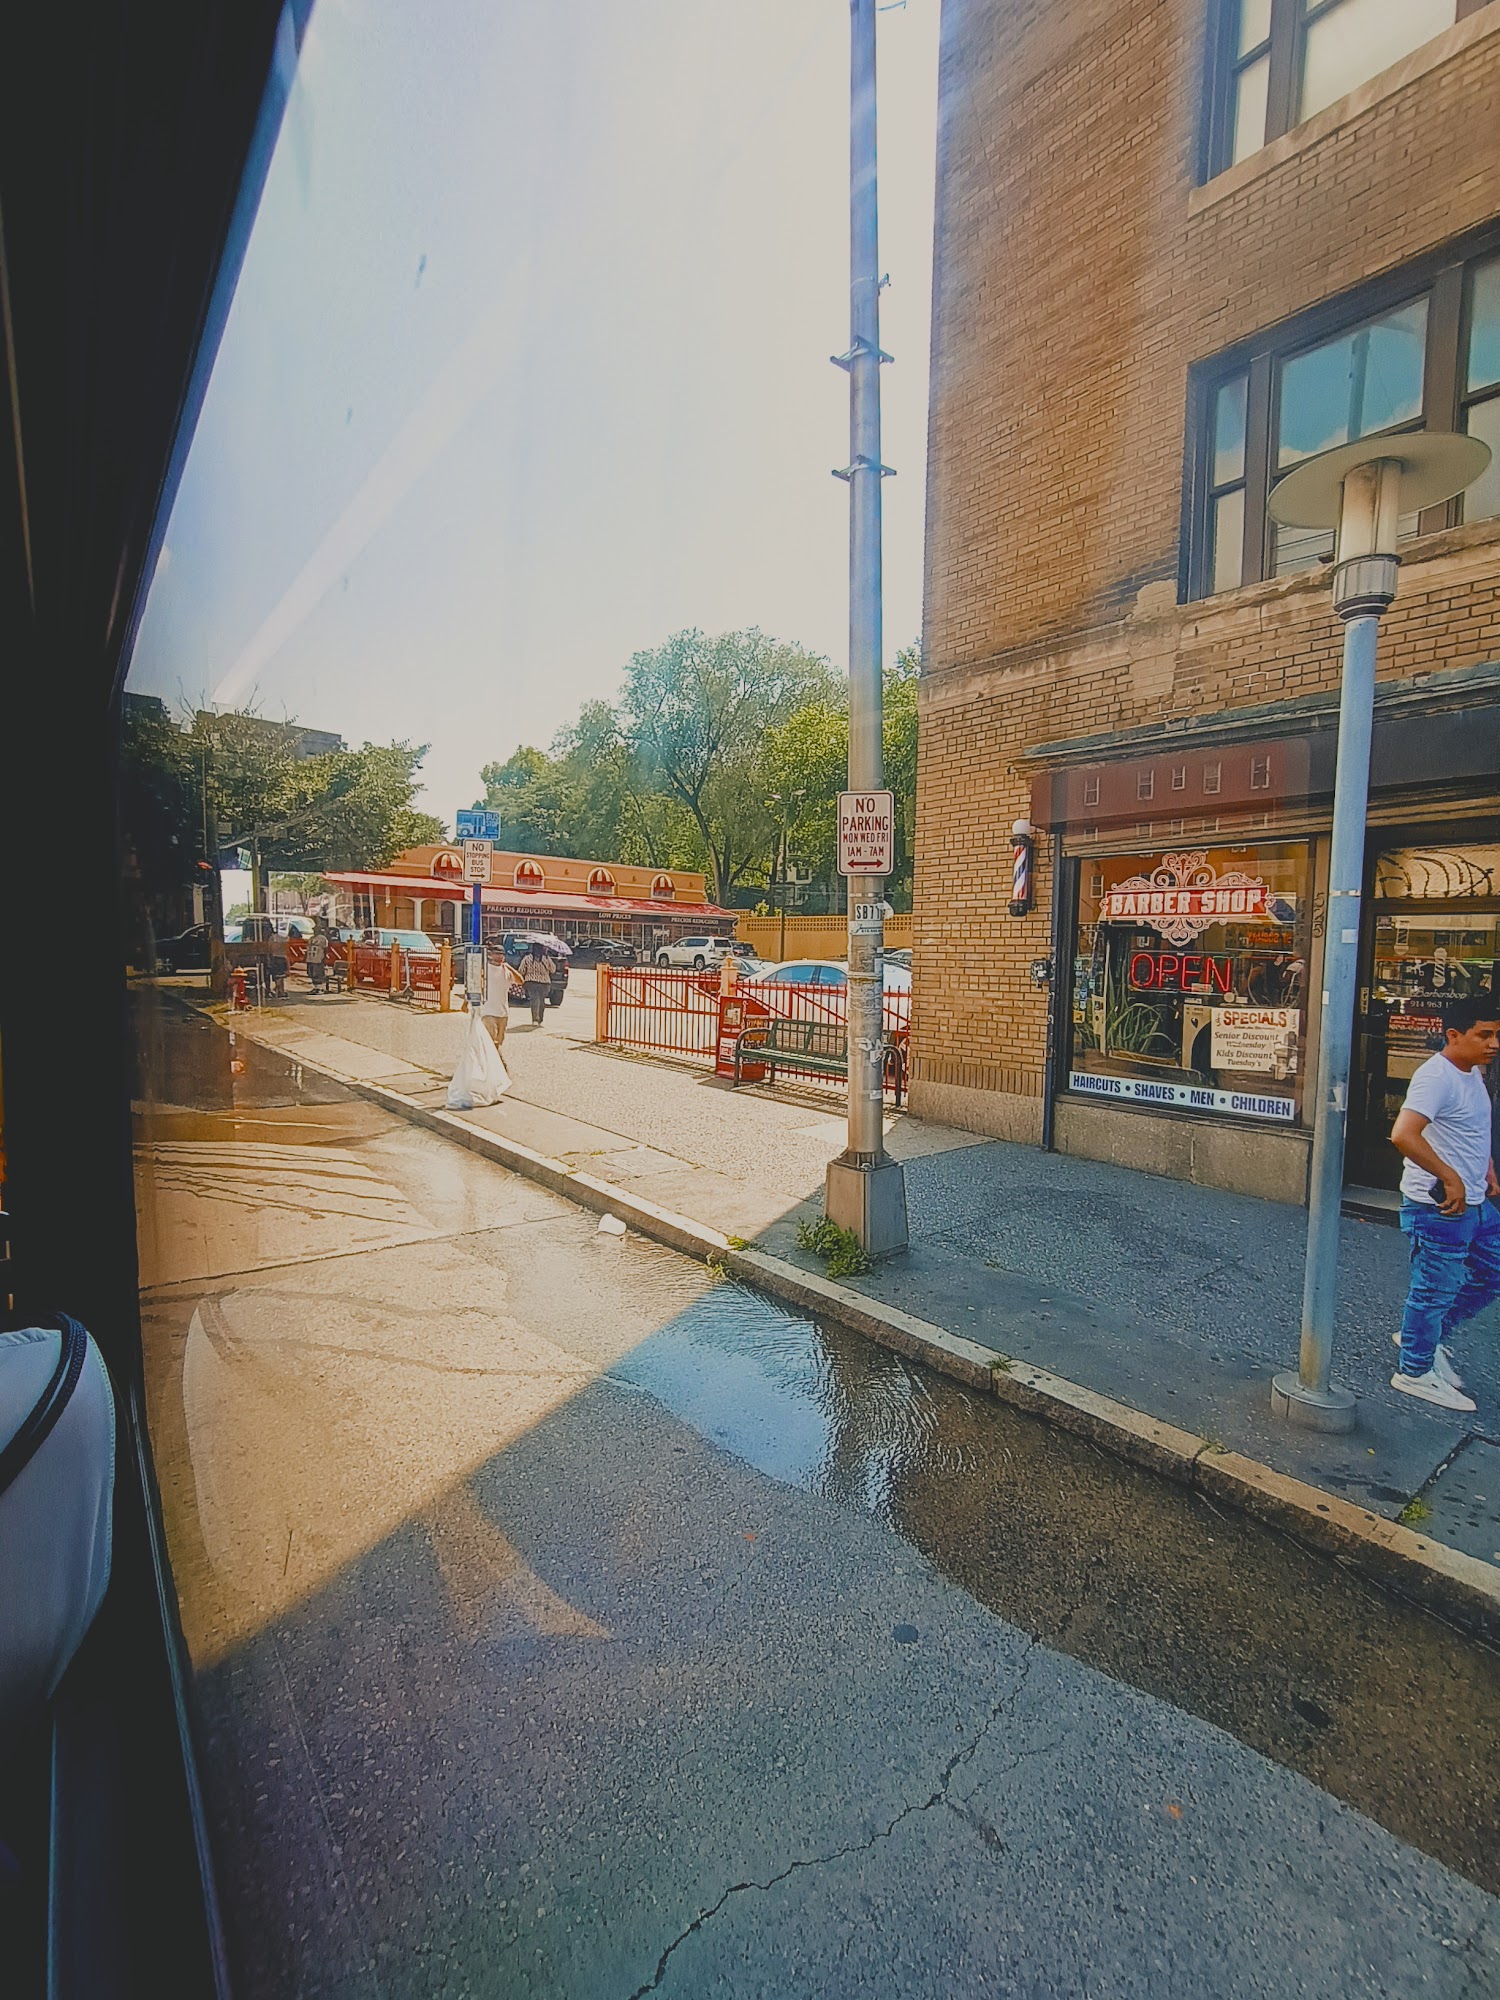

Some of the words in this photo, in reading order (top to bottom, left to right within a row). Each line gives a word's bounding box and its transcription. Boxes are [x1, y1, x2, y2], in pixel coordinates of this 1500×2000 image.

[855, 797, 876, 813] NO
[842, 815, 889, 832] PARKING
[842, 832, 859, 843] MON
[860, 832, 875, 843] WED
[877, 832, 889, 843] FRI
[472, 843, 485, 851] NO
[847, 846, 862, 857] 1AM
[869, 846, 885, 857] 7AM
[1111, 892, 1191, 915] BARBER
[1200, 889, 1263, 914] SHOP
[486, 904, 514, 914] PRECIOS
[515, 906, 553, 916] REDUCIDOS
[1131, 953, 1231, 993] OPEN
[1223, 1010, 1287, 1027] SPECIALS
[1214, 1031, 1240, 1040] Senior
[1242, 1032, 1279, 1041] Discount
[1216, 1049, 1234, 1058] Kids
[1236, 1050, 1273, 1059] Discount
[1227, 1058, 1261, 1067] Tuesday's
[1073, 1074, 1121, 1093] HAIRCUTS
[1134, 1083, 1175, 1101] SHAVES
[1190, 1090, 1215, 1106] MEN
[1231, 1095, 1291, 1116] CHILDREN
